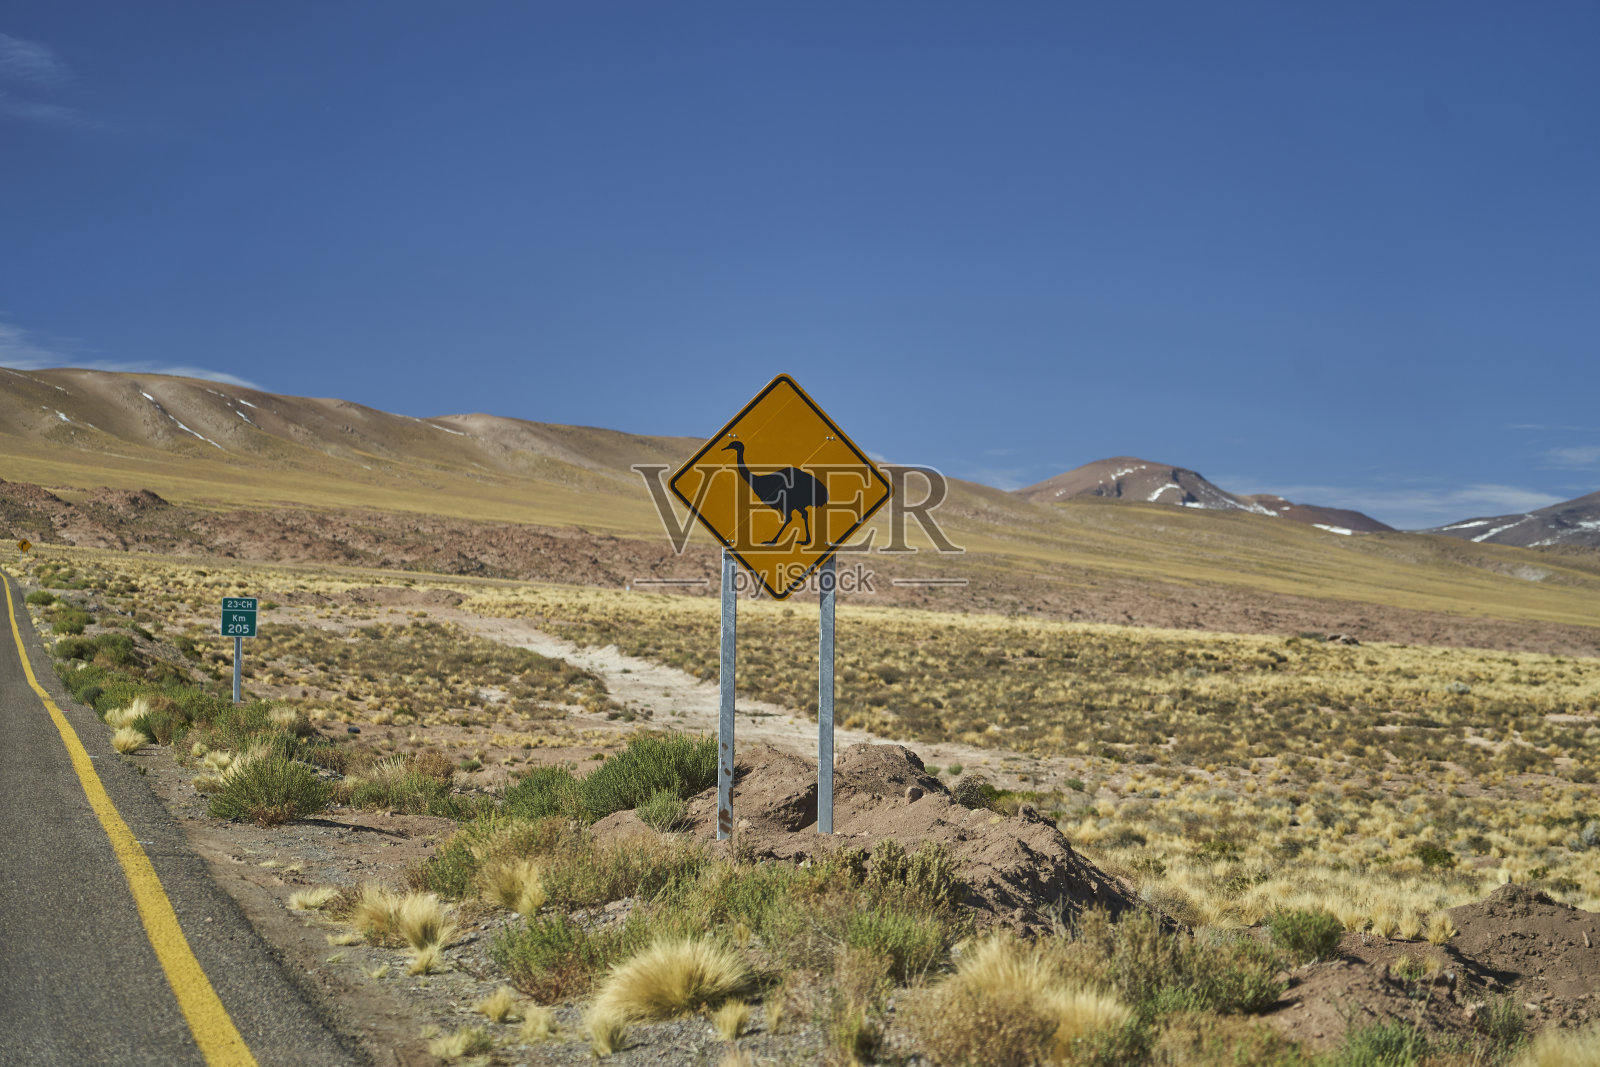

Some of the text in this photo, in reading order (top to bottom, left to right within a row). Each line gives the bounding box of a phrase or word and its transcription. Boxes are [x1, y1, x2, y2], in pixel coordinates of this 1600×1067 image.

[227, 600, 252, 608] 23-CH
[232, 614, 246, 622] Km
[228, 624, 250, 634] 205
